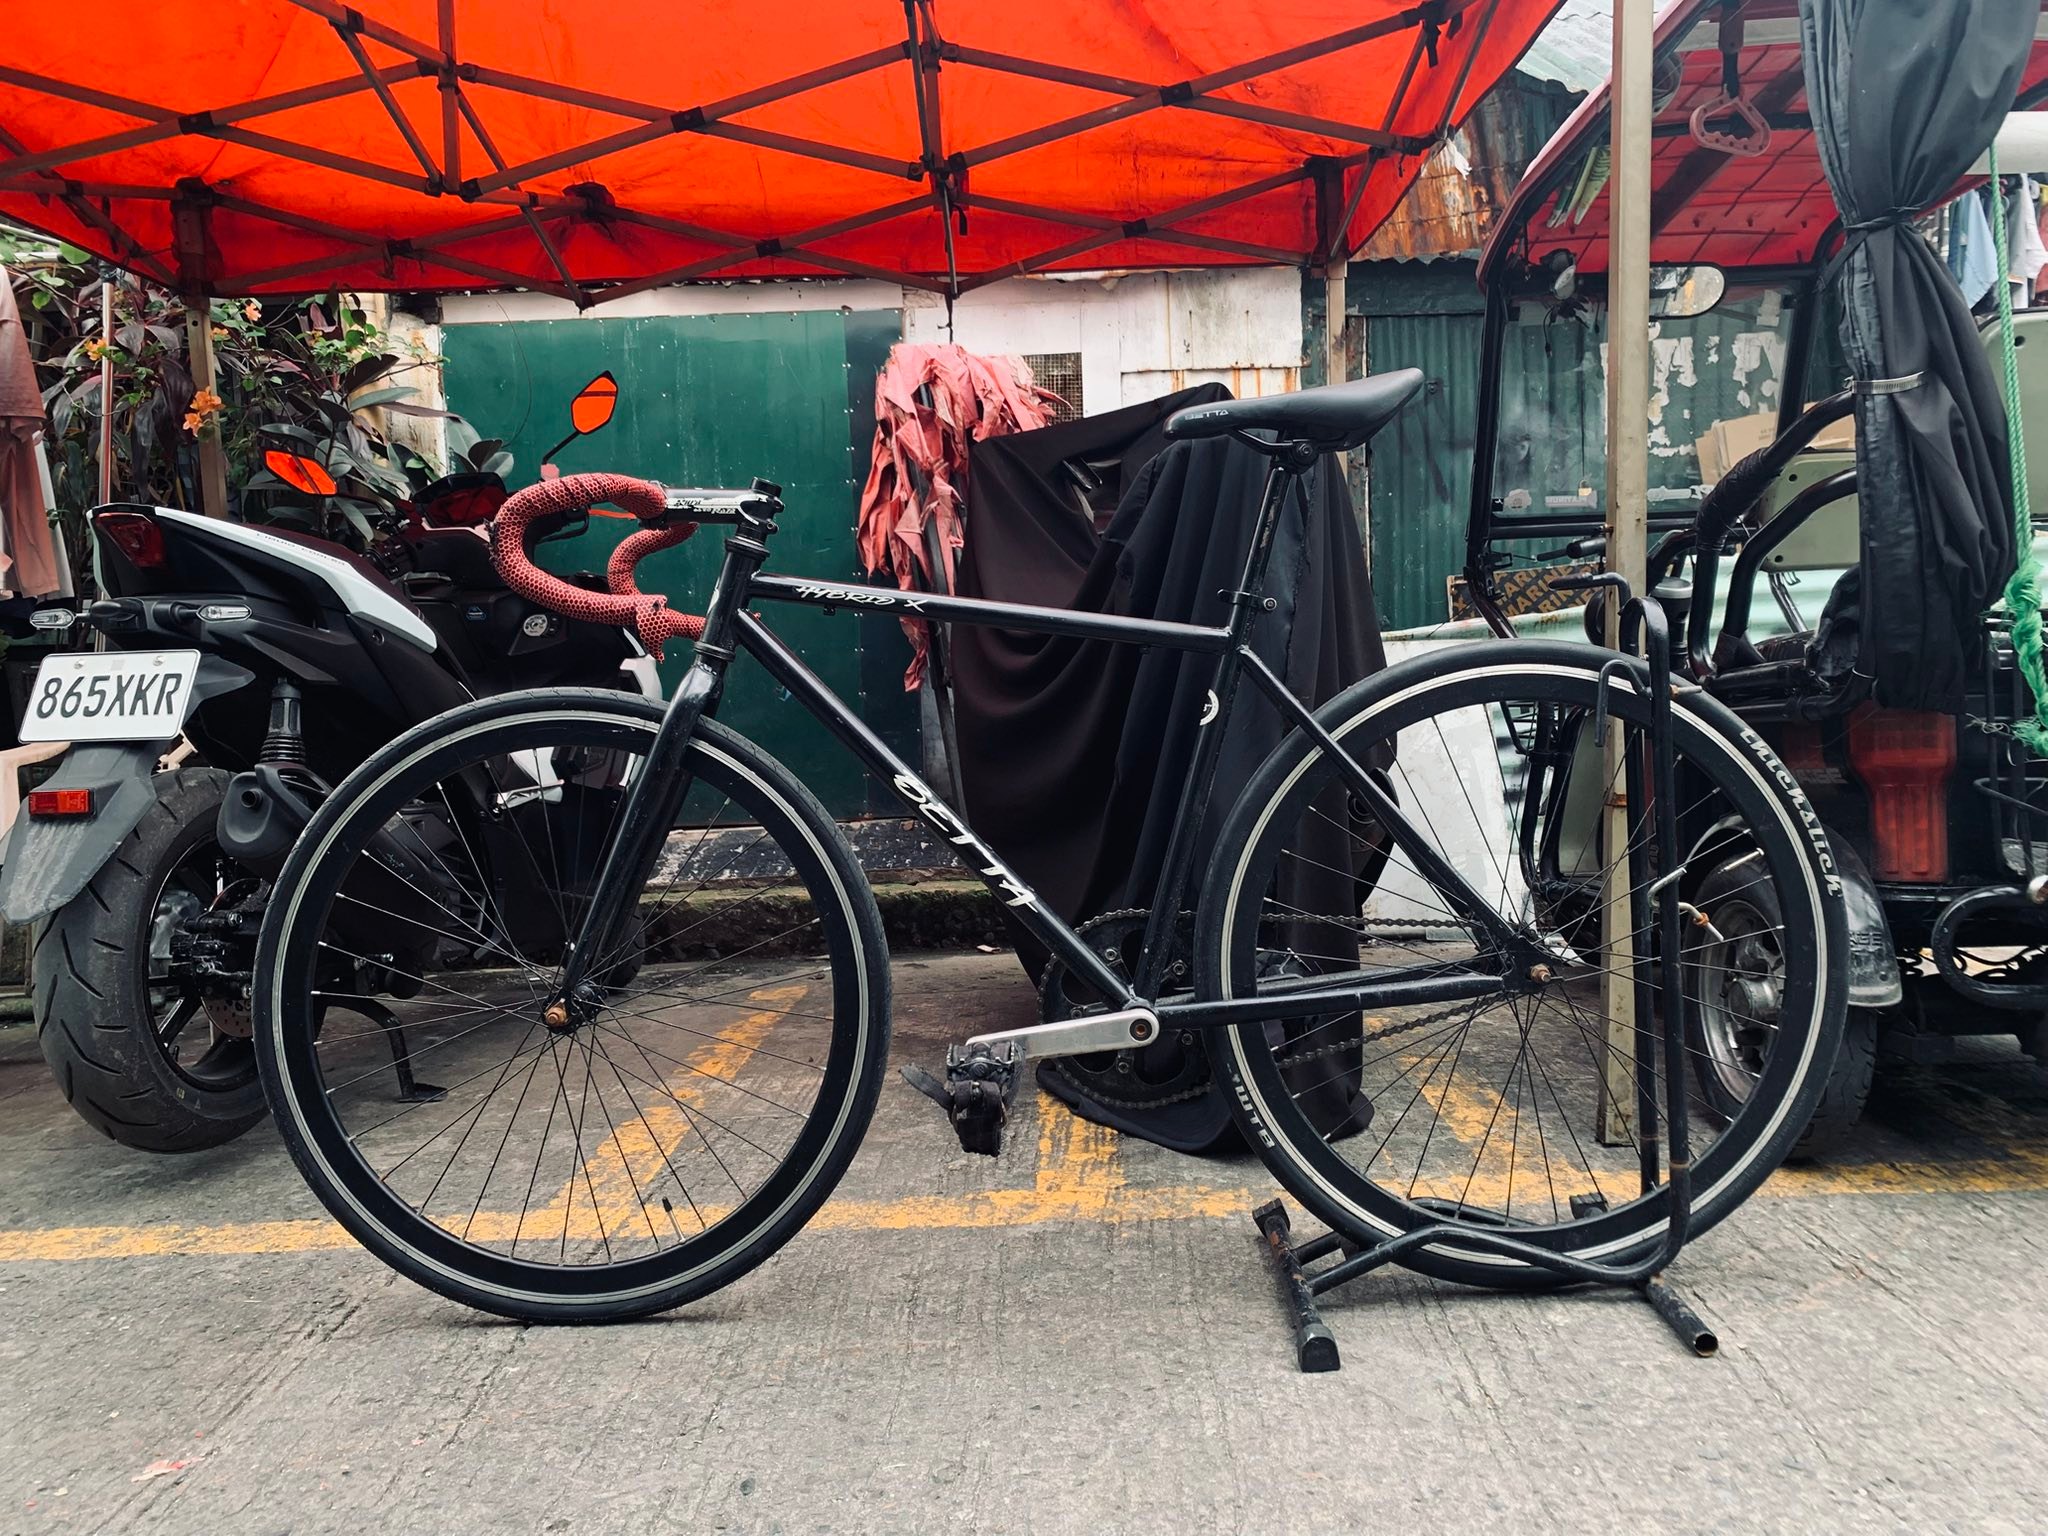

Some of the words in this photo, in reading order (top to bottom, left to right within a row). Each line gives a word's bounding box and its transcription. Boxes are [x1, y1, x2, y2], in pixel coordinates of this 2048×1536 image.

[795, 585, 896, 605] HYBRID
[903, 598, 929, 613] X
[36, 672, 183, 719] 865XKR
[893, 771, 1039, 913] BETTA
